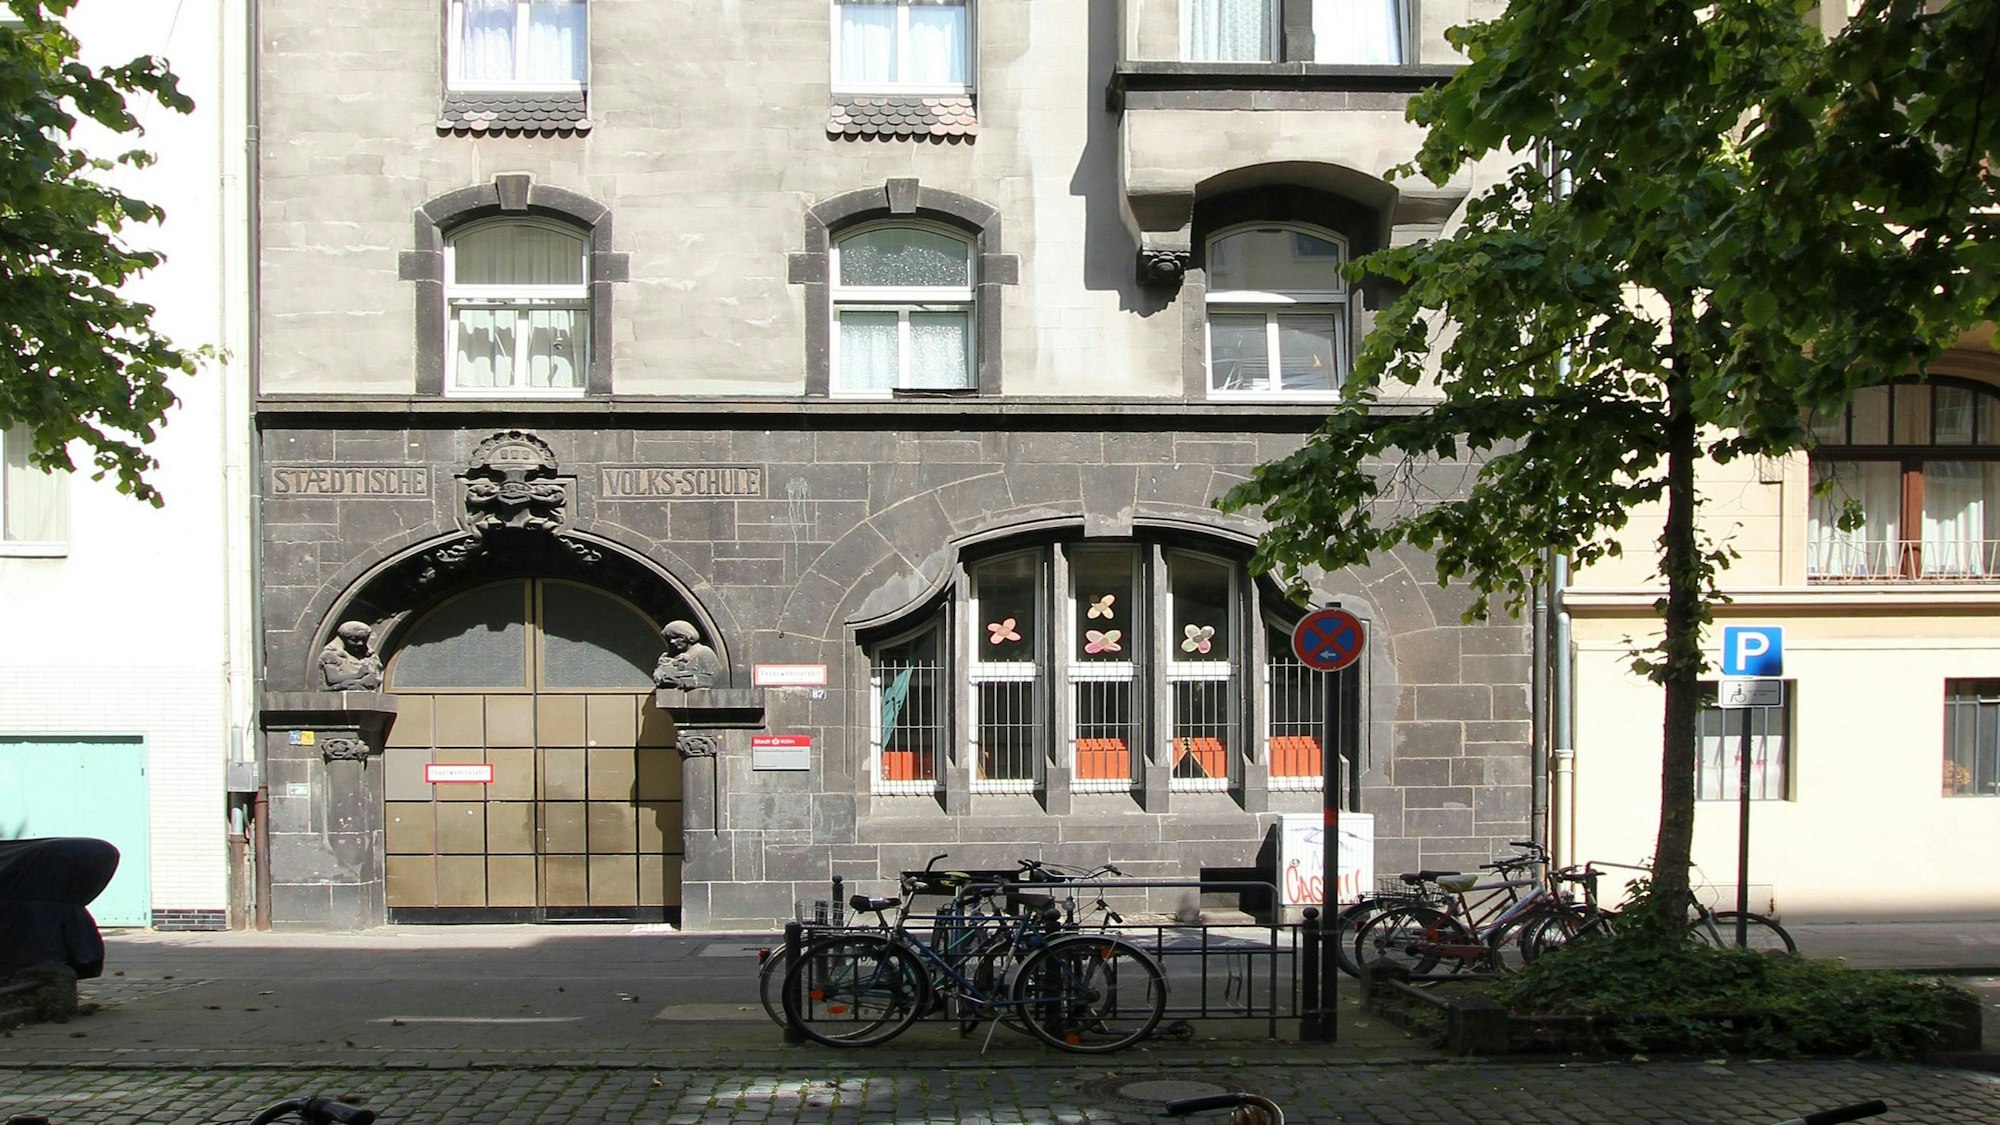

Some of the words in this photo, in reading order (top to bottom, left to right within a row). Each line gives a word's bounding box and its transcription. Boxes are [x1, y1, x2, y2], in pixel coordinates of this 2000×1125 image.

[605, 469, 759, 495] VOLKS-SCHULE
[1736, 631, 1770, 671] P
[811, 689, 826, 699] 87
